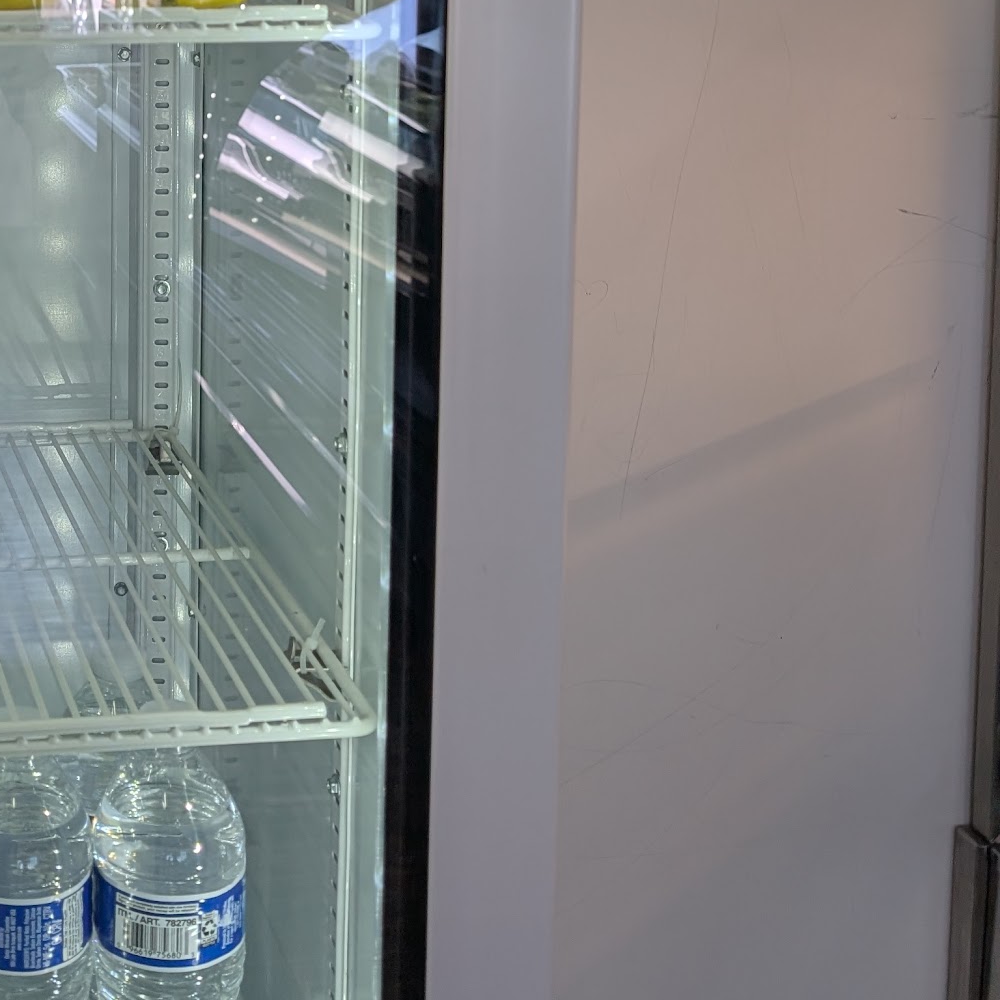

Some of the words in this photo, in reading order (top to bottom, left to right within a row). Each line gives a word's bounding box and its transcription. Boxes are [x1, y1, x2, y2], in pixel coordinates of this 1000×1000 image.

[140, 916, 161, 927] ART.
[166, 918, 197, 928] 782796
[156, 951, 182, 959] 75680
